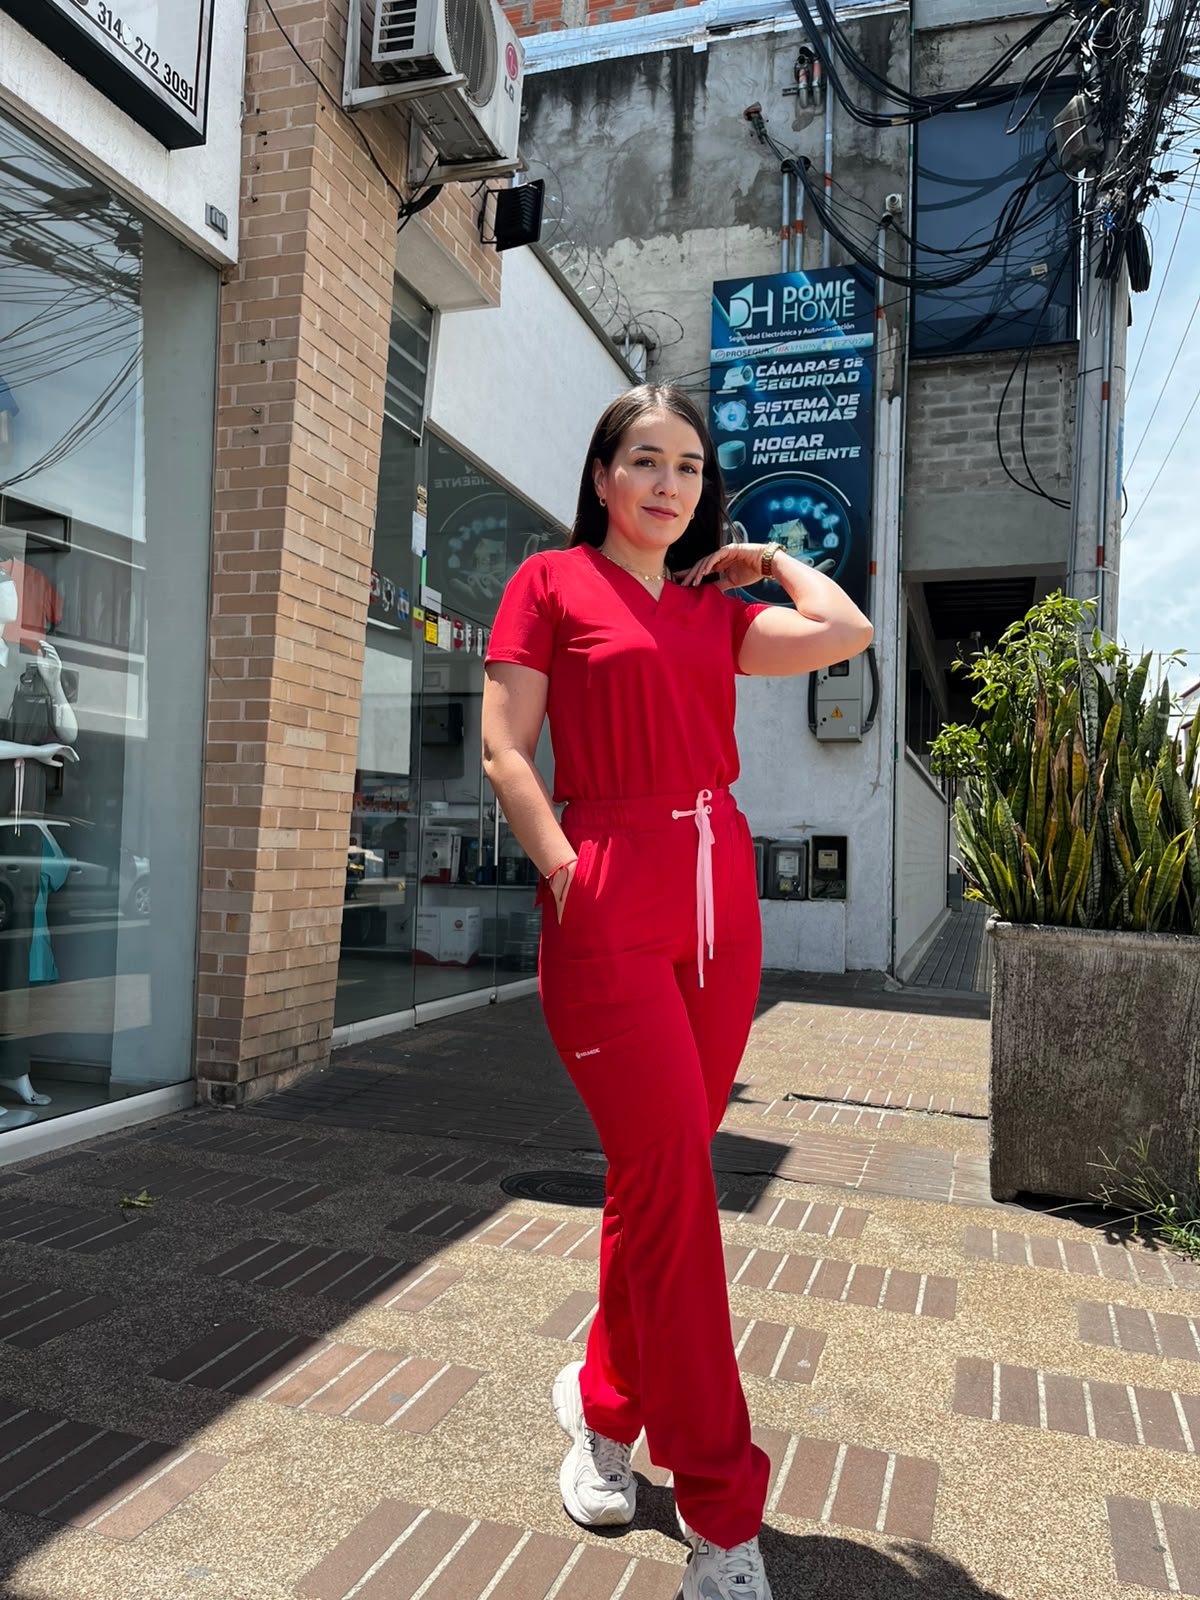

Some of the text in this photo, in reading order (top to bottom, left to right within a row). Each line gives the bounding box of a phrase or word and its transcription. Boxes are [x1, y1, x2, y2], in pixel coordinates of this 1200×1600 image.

[98, 2, 193, 106] 314 272 3091
[504, 75, 514, 102] LG
[783, 279, 856, 303] DOMIC
[782, 296, 855, 324] HOME
[728, 331, 760, 343] Seguridad
[761, 329, 798, 339] Electrónica
[756, 357, 864, 378] CÁMARAS DE
[754, 371, 860, 392] SEGURIDAD
[753, 393, 861, 414] SISTEMA DE
[753, 406, 858, 428] ALARMAS
[753, 433, 825, 452] HOGAR
[752, 446, 861, 465] INTELIGENTE
